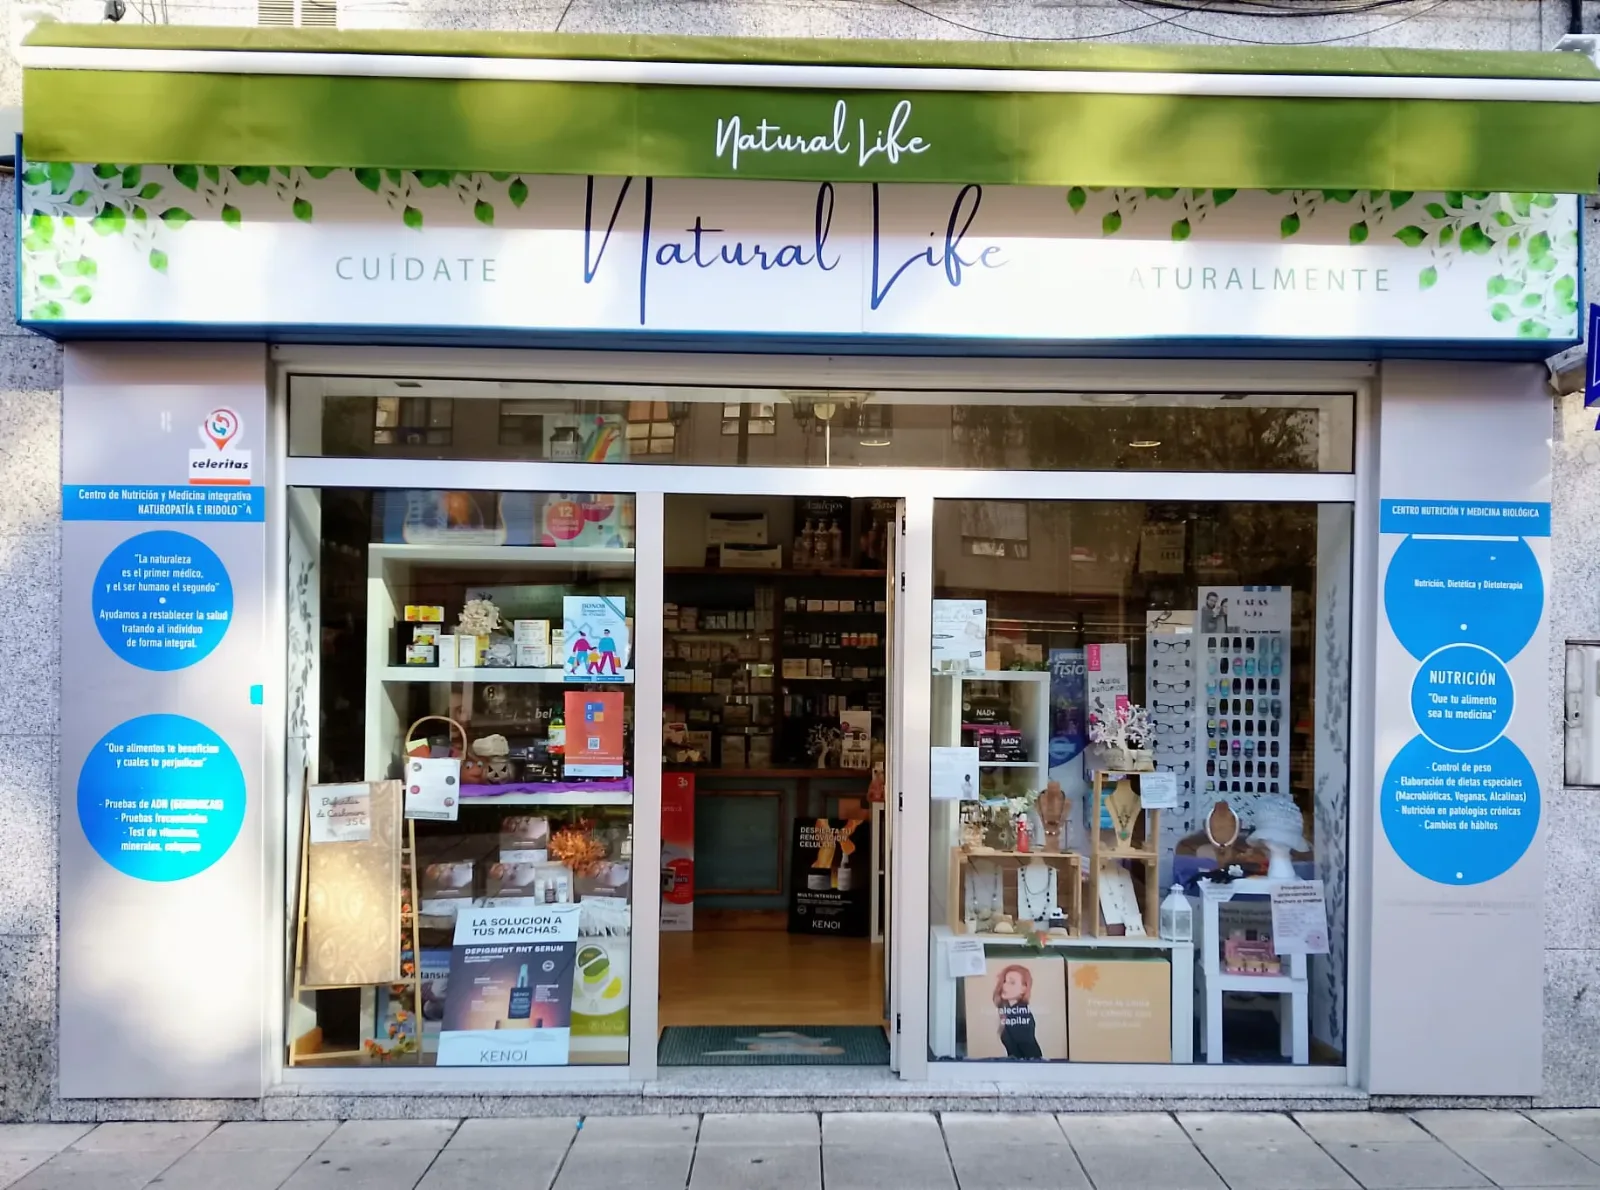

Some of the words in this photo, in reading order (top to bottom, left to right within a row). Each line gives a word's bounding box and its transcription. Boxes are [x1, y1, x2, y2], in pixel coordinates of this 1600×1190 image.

[716, 99, 850, 170] Natural
[858, 99, 931, 167] Life
[584, 176, 842, 325] Natural
[870, 182, 1009, 310] Life
[336, 253, 496, 282] CUÍDATE
[1129, 267, 1390, 291] ATURALMENTE
[192, 458, 249, 471] celeritas
[78, 489, 106, 500] Centro
[108, 489, 119, 500] de
[122, 489, 159, 501] Nutrición
[161, 492, 166, 502] y
[168, 490, 206, 501] Medicina
[208, 490, 252, 503] integrativa
[138, 502, 194, 515] NATUROPATÍA
[197, 504, 202, 515] E
[1392, 506, 1420, 515] CENTRO
[1422, 505, 1459, 516] NUTRICIÓN
[1461, 507, 1465, 516] Y
[1467, 508, 1500, 517] MEDICINA
[1502, 506, 1540, 518] BIOLÓGICA
[150, 554, 191, 565] naturaleza
[122, 570, 131, 578] es
[134, 568, 142, 578] el
[144, 568, 170, 580] primer
[106, 584, 111, 593] y
[113, 582, 121, 592] el
[124, 583, 136, 592] ser
[138, 582, 170, 592] humano
[172, 583, 180, 592] el
[1448, 580, 1476, 589] Dietética
[1478, 582, 1482, 590] y
[1484, 580, 1522, 590] Dietoterapia
[100, 609, 140, 622] Ayudamos
[142, 612, 147, 620] a
[150, 610, 194, 621] restablecer
[196, 611, 204, 621] la
[206, 611, 228, 621] salud
[122, 624, 154, 634] tratando
[157, 624, 164, 634] al
[167, 625, 203, 634] individuo
[126, 638, 136, 648] de
[138, 638, 162, 648] forma
[1430, 670, 1496, 686] NUTRICIÓN
[1450, 695, 1458, 704] tu
[1461, 695, 1496, 706] alimento
[1428, 710, 1442, 718] sea
[1445, 710, 1452, 719] tu
[126, 743, 165, 753] alimentos
[168, 744, 176, 753] te
[116, 759, 121, 769] y
[124, 758, 149, 768] cuales
[151, 758, 159, 768] te
[1432, 762, 1460, 772] Control
[1462, 763, 1471, 772] de
[1474, 764, 1492, 774] peso
[1400, 776, 1444, 787] Elaboración
[1446, 777, 1456, 787] de
[1458, 777, 1480, 787] dietas
[1482, 778, 1522, 788] especiales
[1490, 792, 1526, 803] Alcalinas)
[105, 800, 136, 809] Pruebas
[139, 800, 148, 809] de
[1402, 805, 1436, 816] Nutrición
[1437, 807, 1446, 816] en
[1490, 806, 1521, 816] crónicas
[121, 814, 153, 824] Pruebas
[1424, 820, 1457, 830] Cambios
[1459, 821, 1468, 830] de
[1470, 820, 1498, 831] hábitos
[128, 827, 144, 837] Test
[472, 919, 486, 927] LA
[490, 917, 551, 926] SOLUCION
[554, 916, 562, 924] A
[812, 920, 841, 930] KENOI
[472, 928, 494, 936] TUS
[498, 926, 561, 936] MANCHAS.
[1000, 1016, 1030, 1026] capilar
[480, 1050, 528, 1063] KENOI
